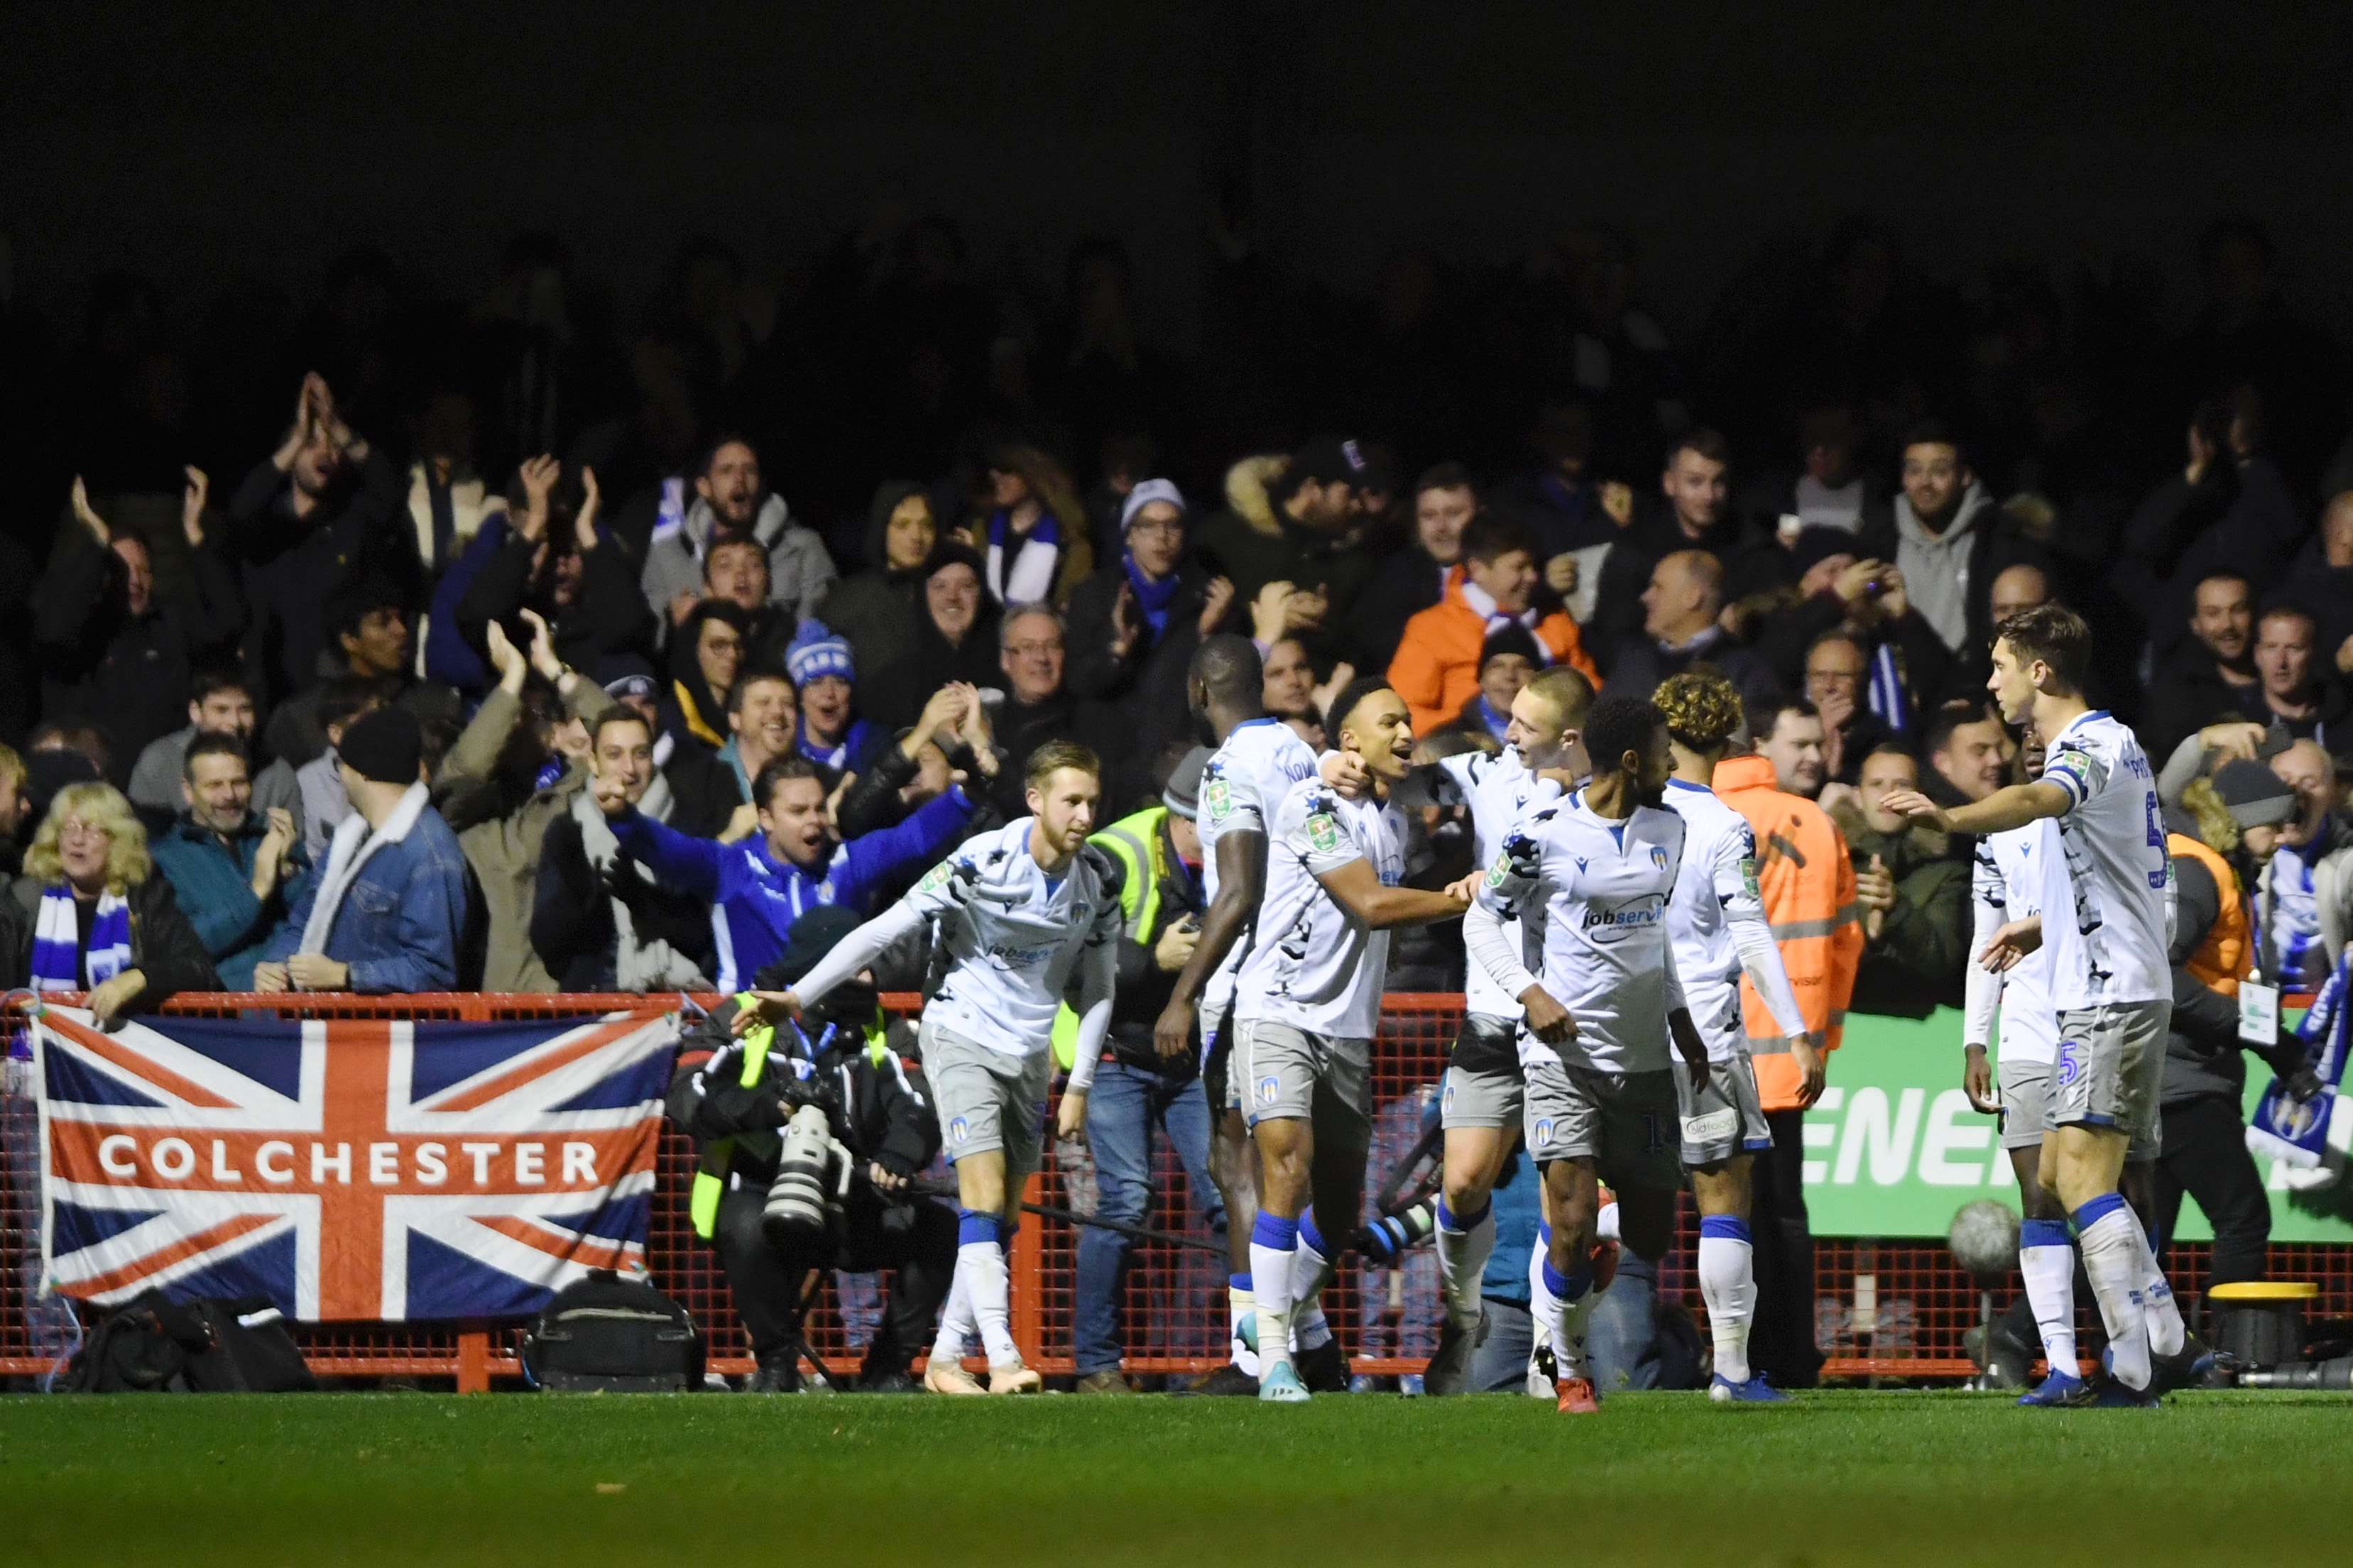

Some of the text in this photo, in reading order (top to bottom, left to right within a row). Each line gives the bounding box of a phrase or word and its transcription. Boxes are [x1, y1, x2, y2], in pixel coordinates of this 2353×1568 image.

[2146, 791, 2166, 889] 5
[2059, 1041, 2078, 1085] 5
[99, 1134, 599, 1185] COLCHESTER
